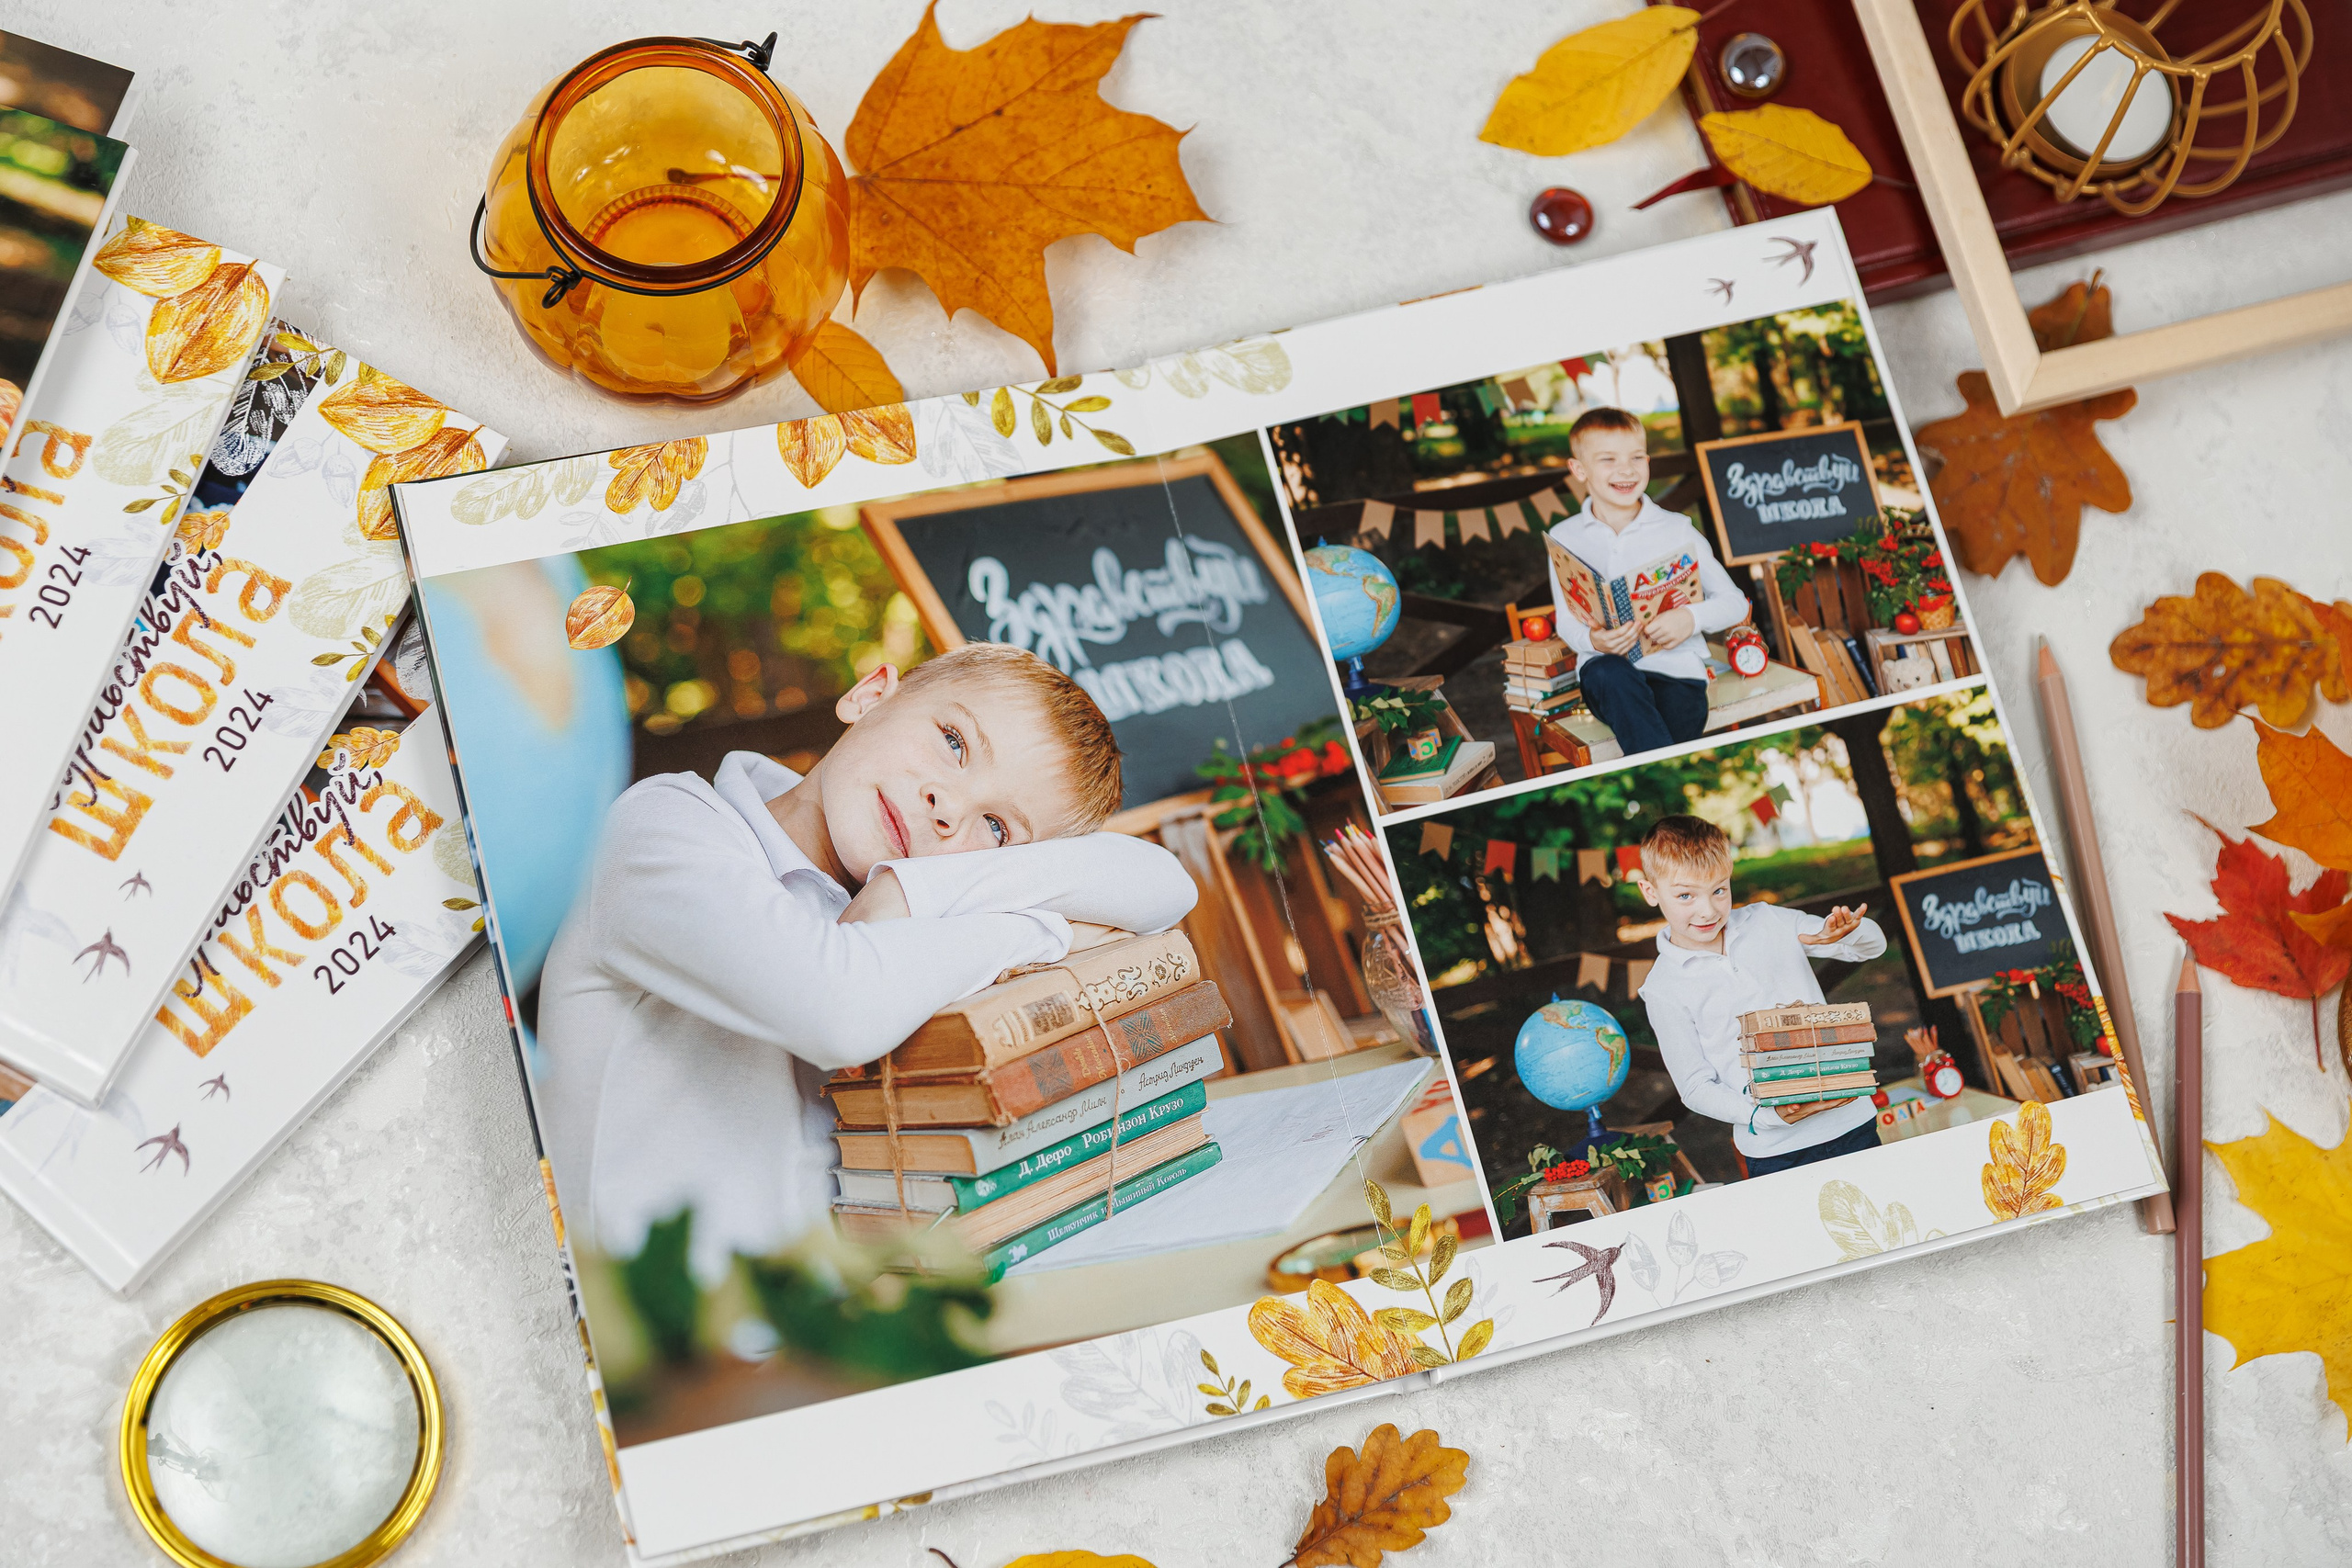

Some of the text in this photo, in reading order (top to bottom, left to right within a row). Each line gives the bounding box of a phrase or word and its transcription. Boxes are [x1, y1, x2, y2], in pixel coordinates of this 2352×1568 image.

[28, 545, 92, 629] 2024
[203, 688, 275, 773] 2024
[313, 915, 397, 995] 2024
[1018, 1161, 1034, 1179] Д.
[1035, 1145, 1073, 1171] Дефо
